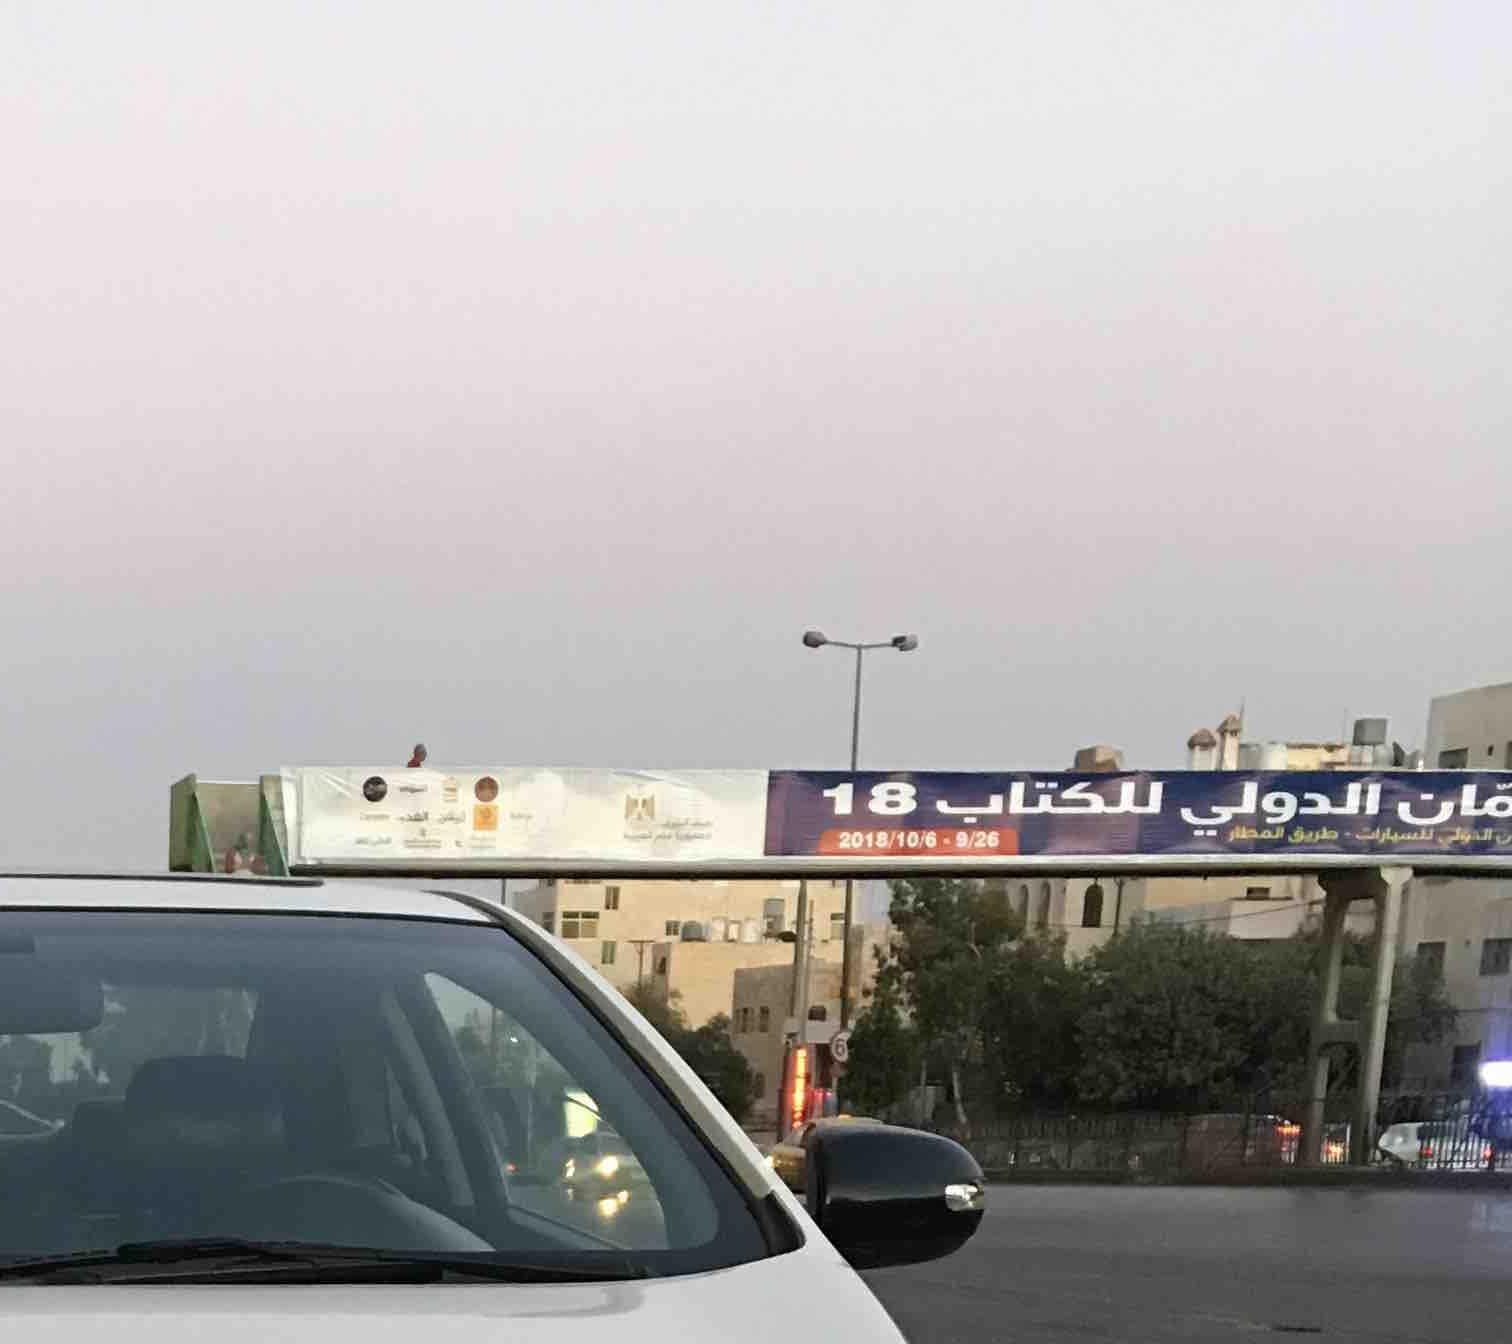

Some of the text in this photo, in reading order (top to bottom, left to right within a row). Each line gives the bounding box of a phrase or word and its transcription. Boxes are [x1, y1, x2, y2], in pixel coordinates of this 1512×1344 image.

[822, 782, 917, 815] 18
[936, 781, 1163, 823] للكتاب
[1180, 781, 1382, 836] الدولي
[838, 831, 937, 850] 2018/10/6
[955, 831, 1000, 849] 9/26
[1229, 824, 1285, 842] المطار
[1288, 826, 1339, 843] طريق
